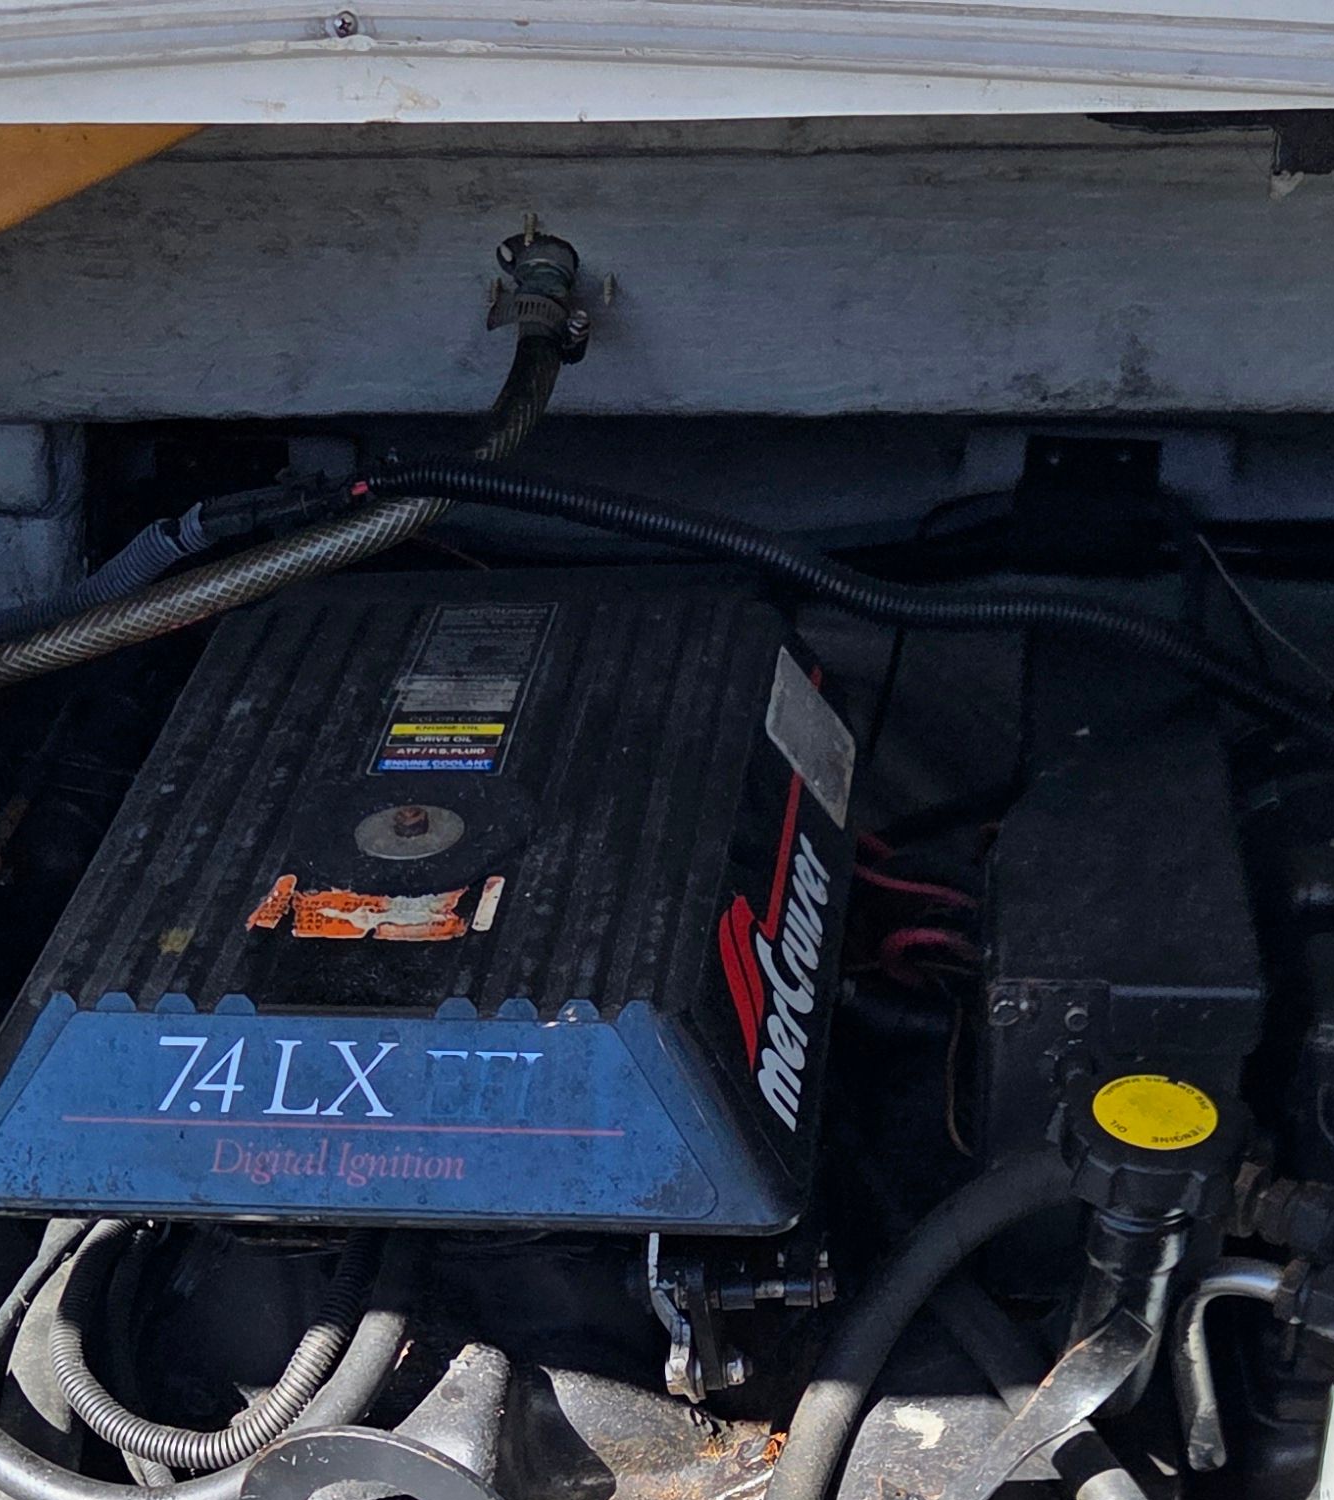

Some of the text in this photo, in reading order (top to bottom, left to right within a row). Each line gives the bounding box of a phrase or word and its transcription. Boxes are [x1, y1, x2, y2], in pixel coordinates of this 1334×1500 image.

[415, 735, 472, 743] DRIVE OIL
[432, 759, 493, 770] COOLANT
[158, 1035, 245, 1113] 7.4
[262, 1038, 400, 1118] LX
[1110, 1120, 1128, 1133] OIL
[211, 1138, 465, 1187] Digital Ignition
